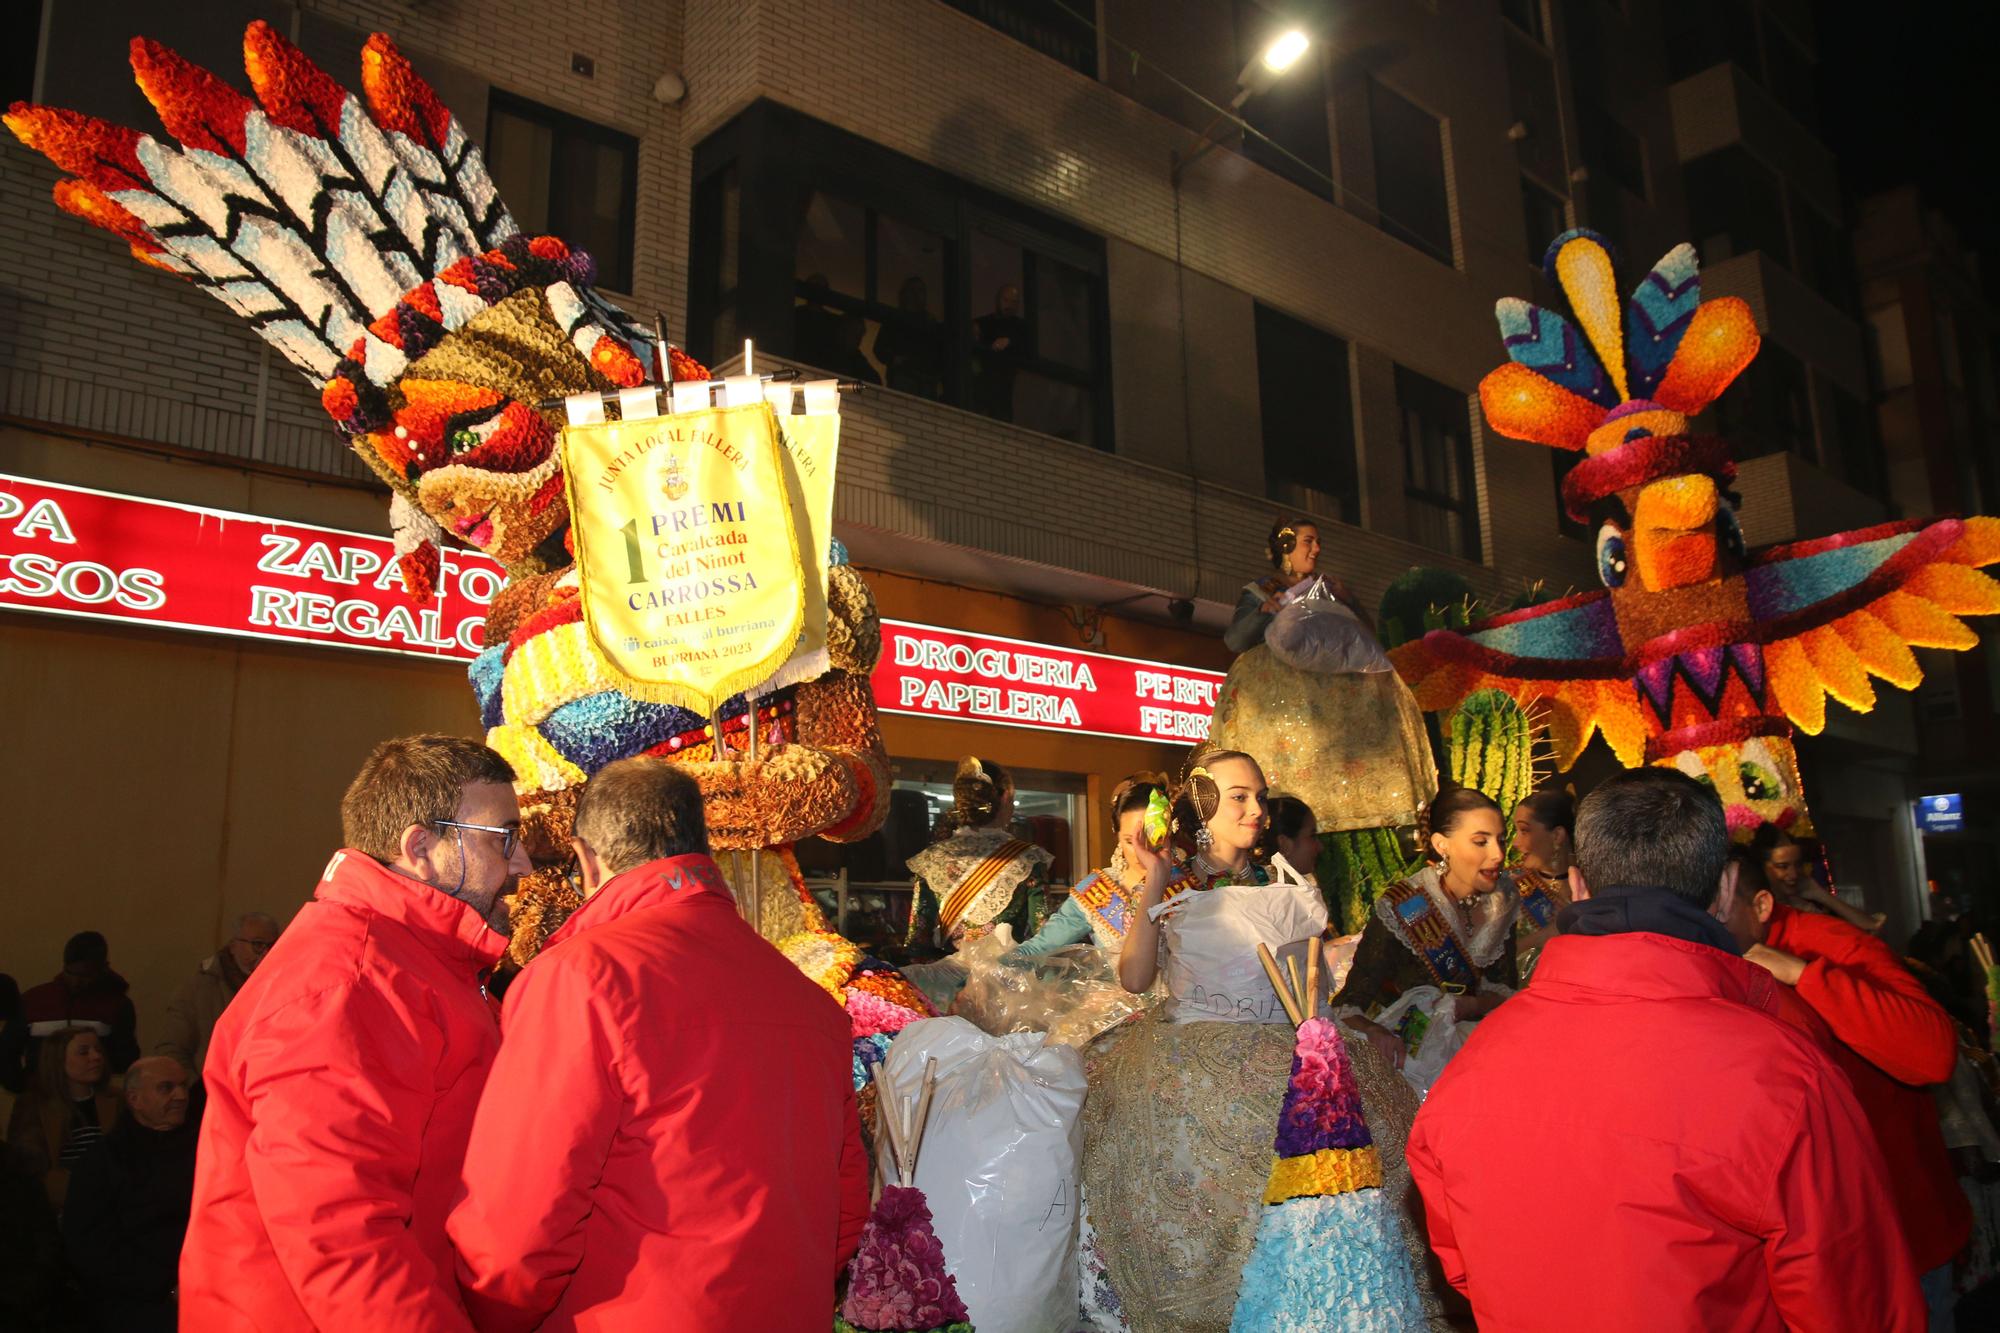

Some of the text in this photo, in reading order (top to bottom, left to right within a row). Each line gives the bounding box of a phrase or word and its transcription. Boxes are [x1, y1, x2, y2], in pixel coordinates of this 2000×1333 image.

[599, 450, 636, 493] JUNTA
[635, 428, 685, 455] LOCAL
[651, 501, 746, 536] PREMI
[619, 518, 649, 584] 1
[657, 530, 748, 559] Cavalcada
[0, 553, 167, 610] SOS
[257, 534, 510, 605] ZAPATO
[665, 550, 746, 580] del Ninot
[628, 572, 757, 611] CARROSSA
[644, 637, 678, 649] caixa
[717, 618, 776, 637] burriana
[665, 606, 726, 627] FALLES
[722, 642, 752, 657] 2023
[894, 635, 1096, 692] DROGUERIA
[900, 676, 1081, 726] PAPELERIA
[1140, 706, 1212, 739] FERR
